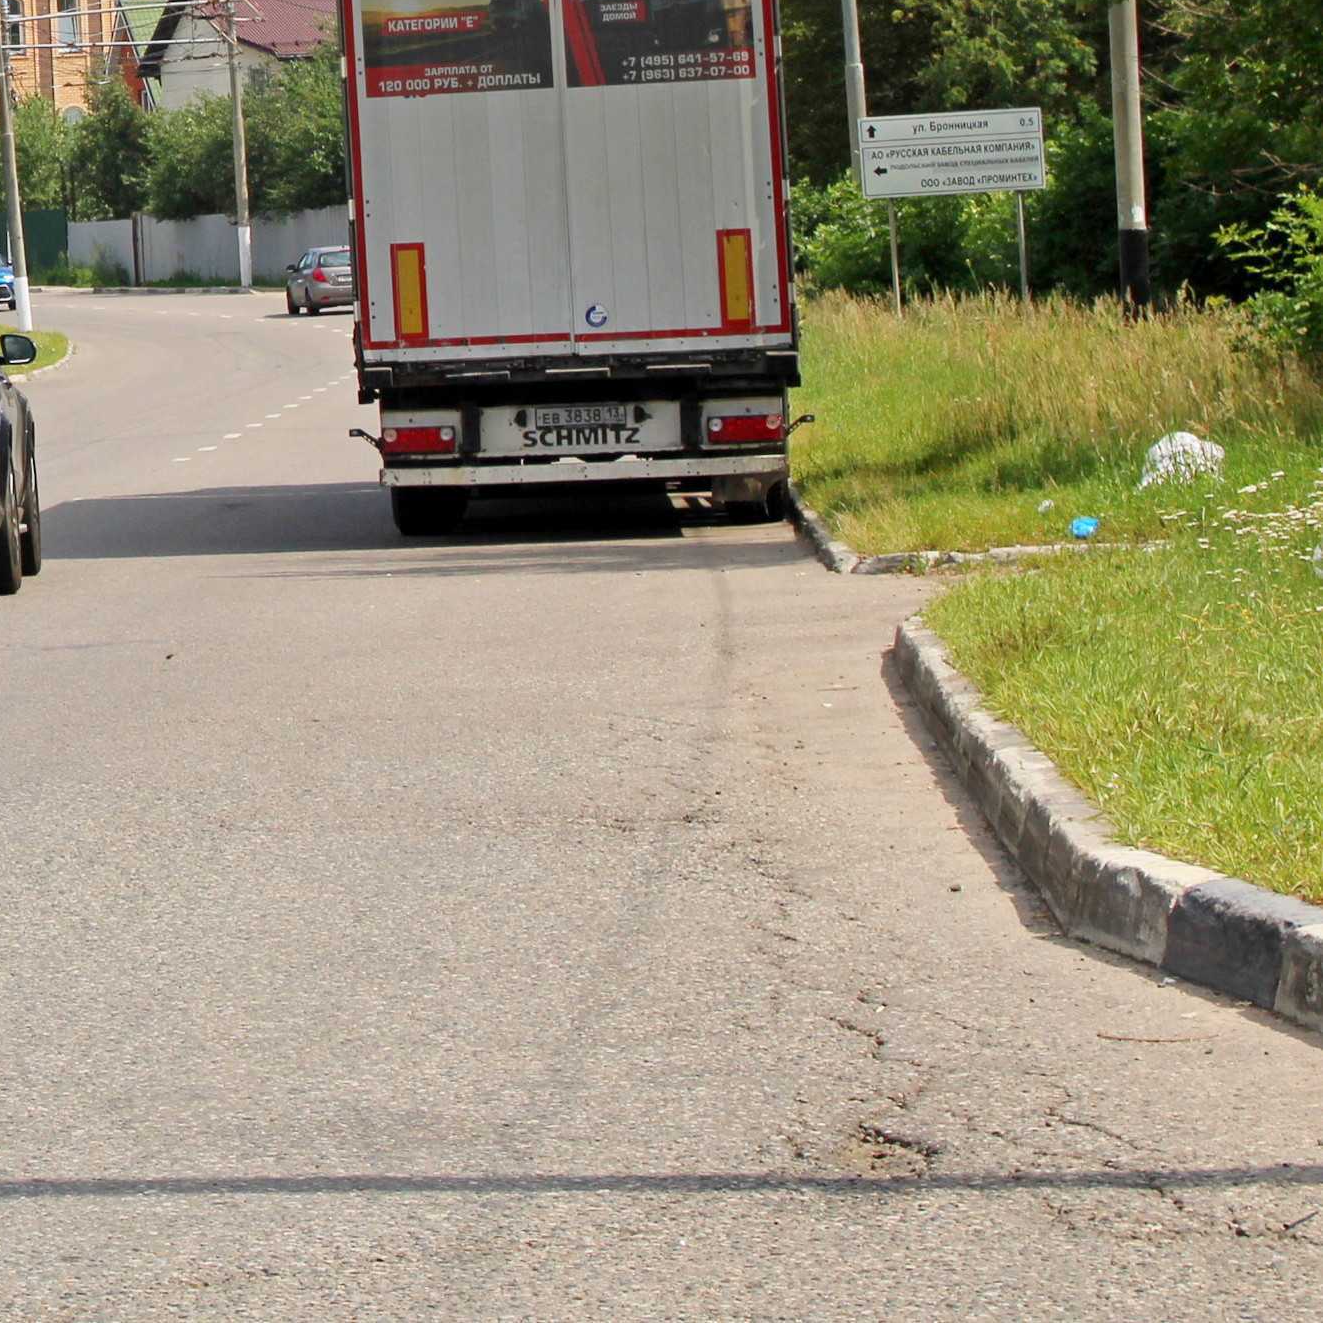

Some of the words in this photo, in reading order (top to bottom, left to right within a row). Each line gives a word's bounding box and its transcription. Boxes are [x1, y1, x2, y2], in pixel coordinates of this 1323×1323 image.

[600, 2, 638, 12] ЗАЕЗДЫ
[603, 10, 637, 22] ДОМОЙ
[388, 17, 458, 32] КАТЕГОРИИ
[622, 57, 636, 67] +7
[640, 55, 674, 67] (495)
[424, 67, 477, 77] ЗАРПЛАТА
[480, 64, 494, 74] ОТ
[623, 70, 636, 81] +7
[641, 68, 675, 81] (963)
[678, 65, 750, 78] 637-07-00
[378, 80, 402, 92] 120
[405, 79, 431, 91] 000
[434, 78, 463, 89] РУБ.
[477, 73, 541, 88] ДОПЛАТЫ
[912, 124, 927, 134] ул.
[929, 121, 989, 133] Бронницкая
[872, 151, 884, 159] АО
[886, 147, 929, 158] «РУССКАЯ
[931, 144, 982, 156] КАБЕЛЬНАЯ
[984, 141, 1035, 153] КОМПАНИЯ»
[920, 178, 940, 187] ООО
[564, 408, 601, 423] 3838
[522, 426, 641, 447] SCHMITZ
